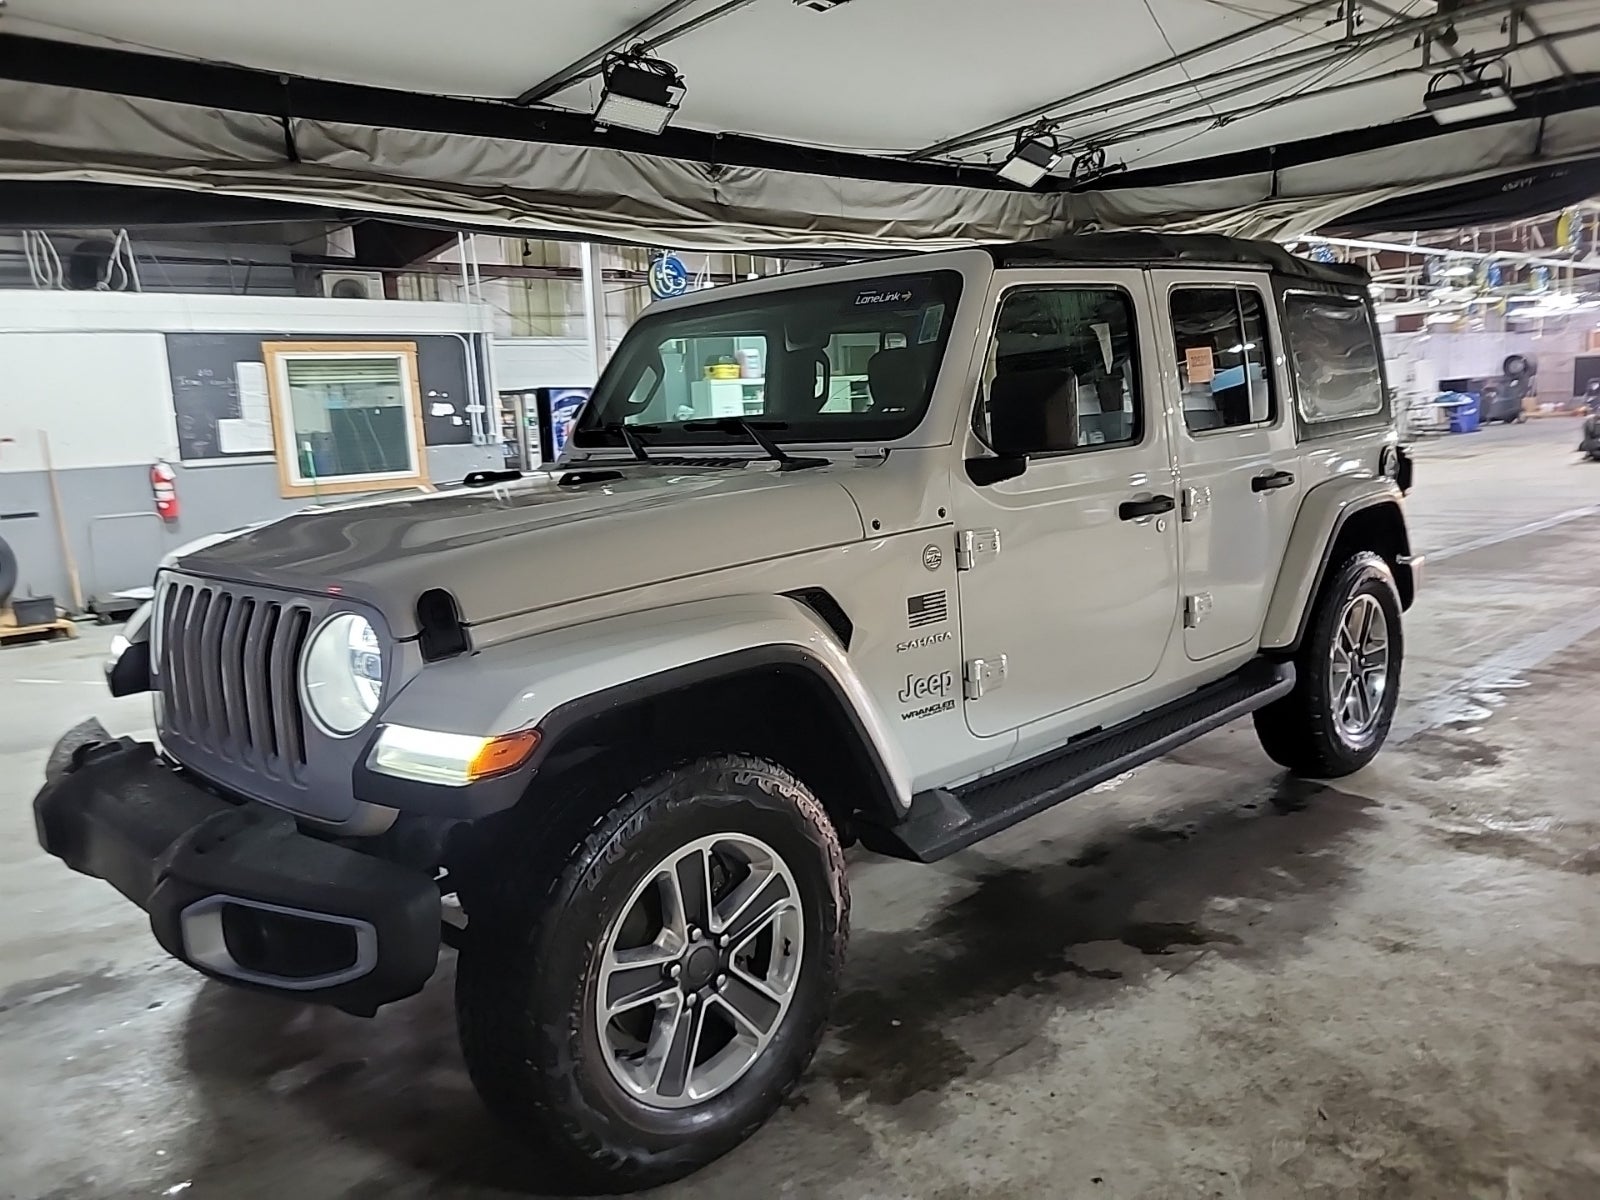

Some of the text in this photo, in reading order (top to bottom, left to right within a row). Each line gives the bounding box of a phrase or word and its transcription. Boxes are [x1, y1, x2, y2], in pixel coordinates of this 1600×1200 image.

[855, 292, 900, 305] LaneLink
[896, 631, 952, 653] SAHARA
[898, 670, 952, 703] Jeep
[901, 699, 955, 720] WRANGLER
